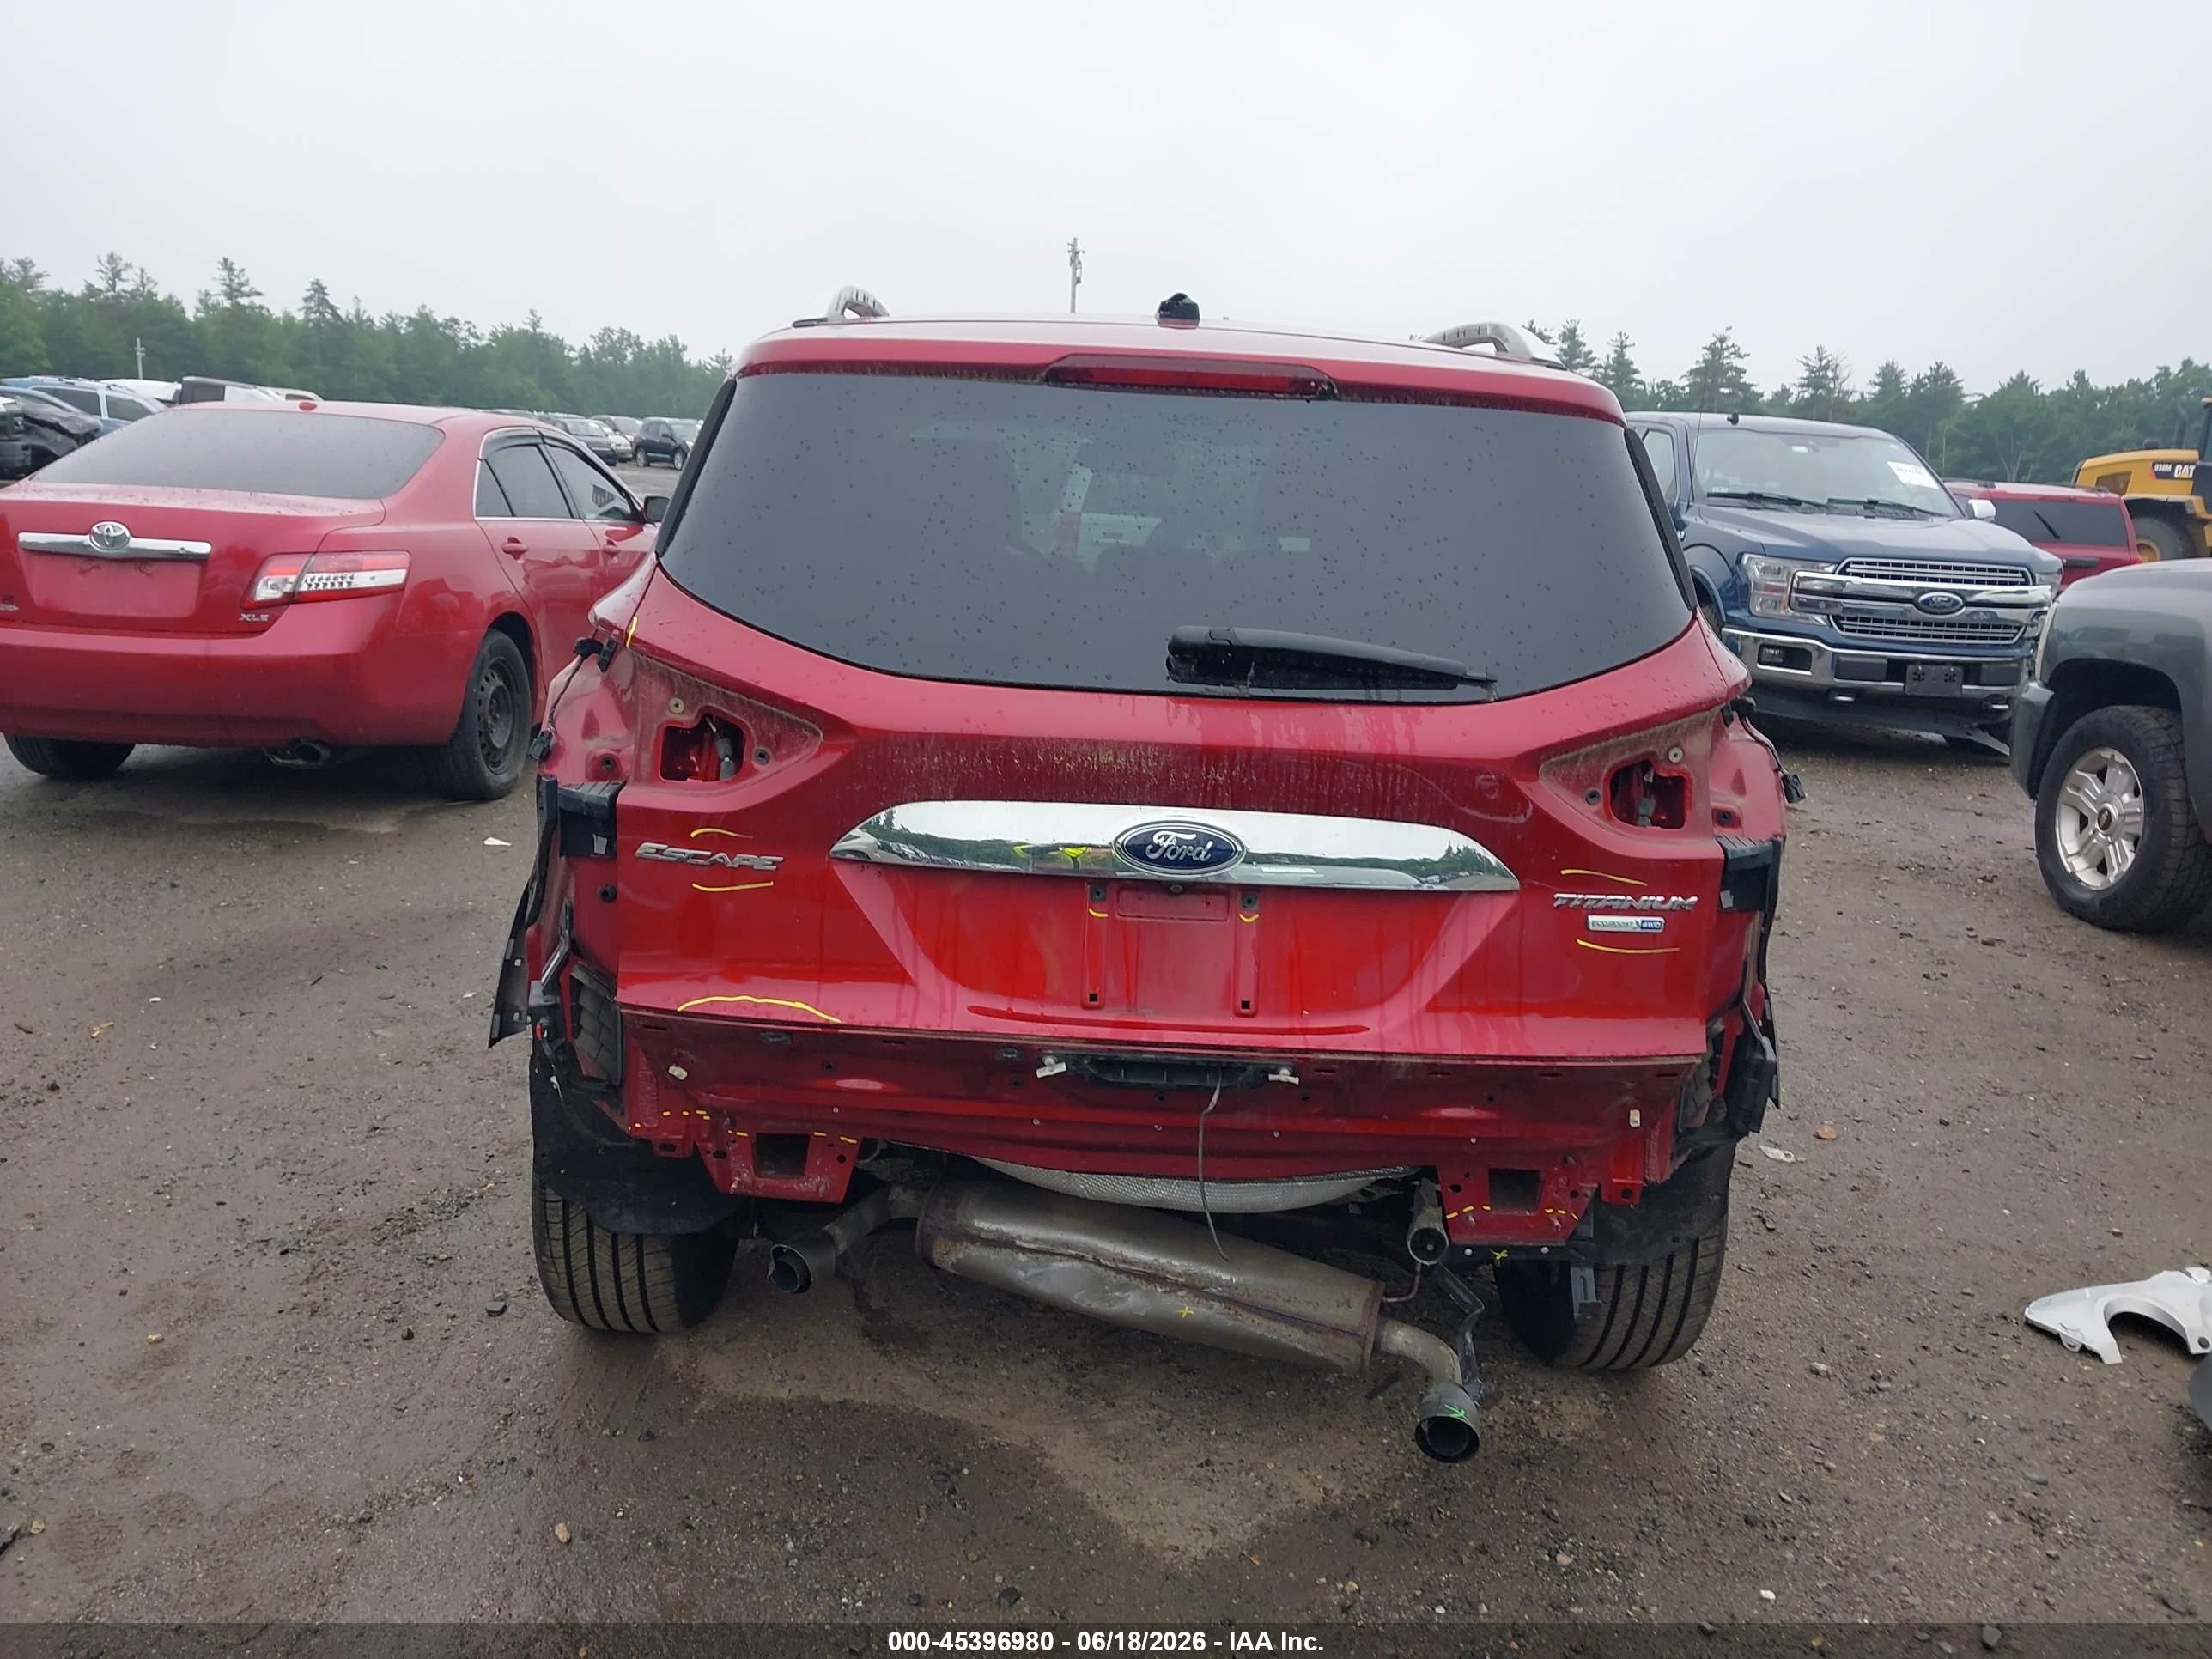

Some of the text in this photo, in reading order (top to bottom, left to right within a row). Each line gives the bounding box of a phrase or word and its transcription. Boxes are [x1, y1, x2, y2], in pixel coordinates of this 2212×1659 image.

[2174, 464, 2196, 478] CAT
[1146, 830, 1214, 861] Ford
[635, 842, 784, 872] ESCAPE
[1553, 893, 1698, 911] TITANIUM
[1641, 920, 1662, 929] 4WD
